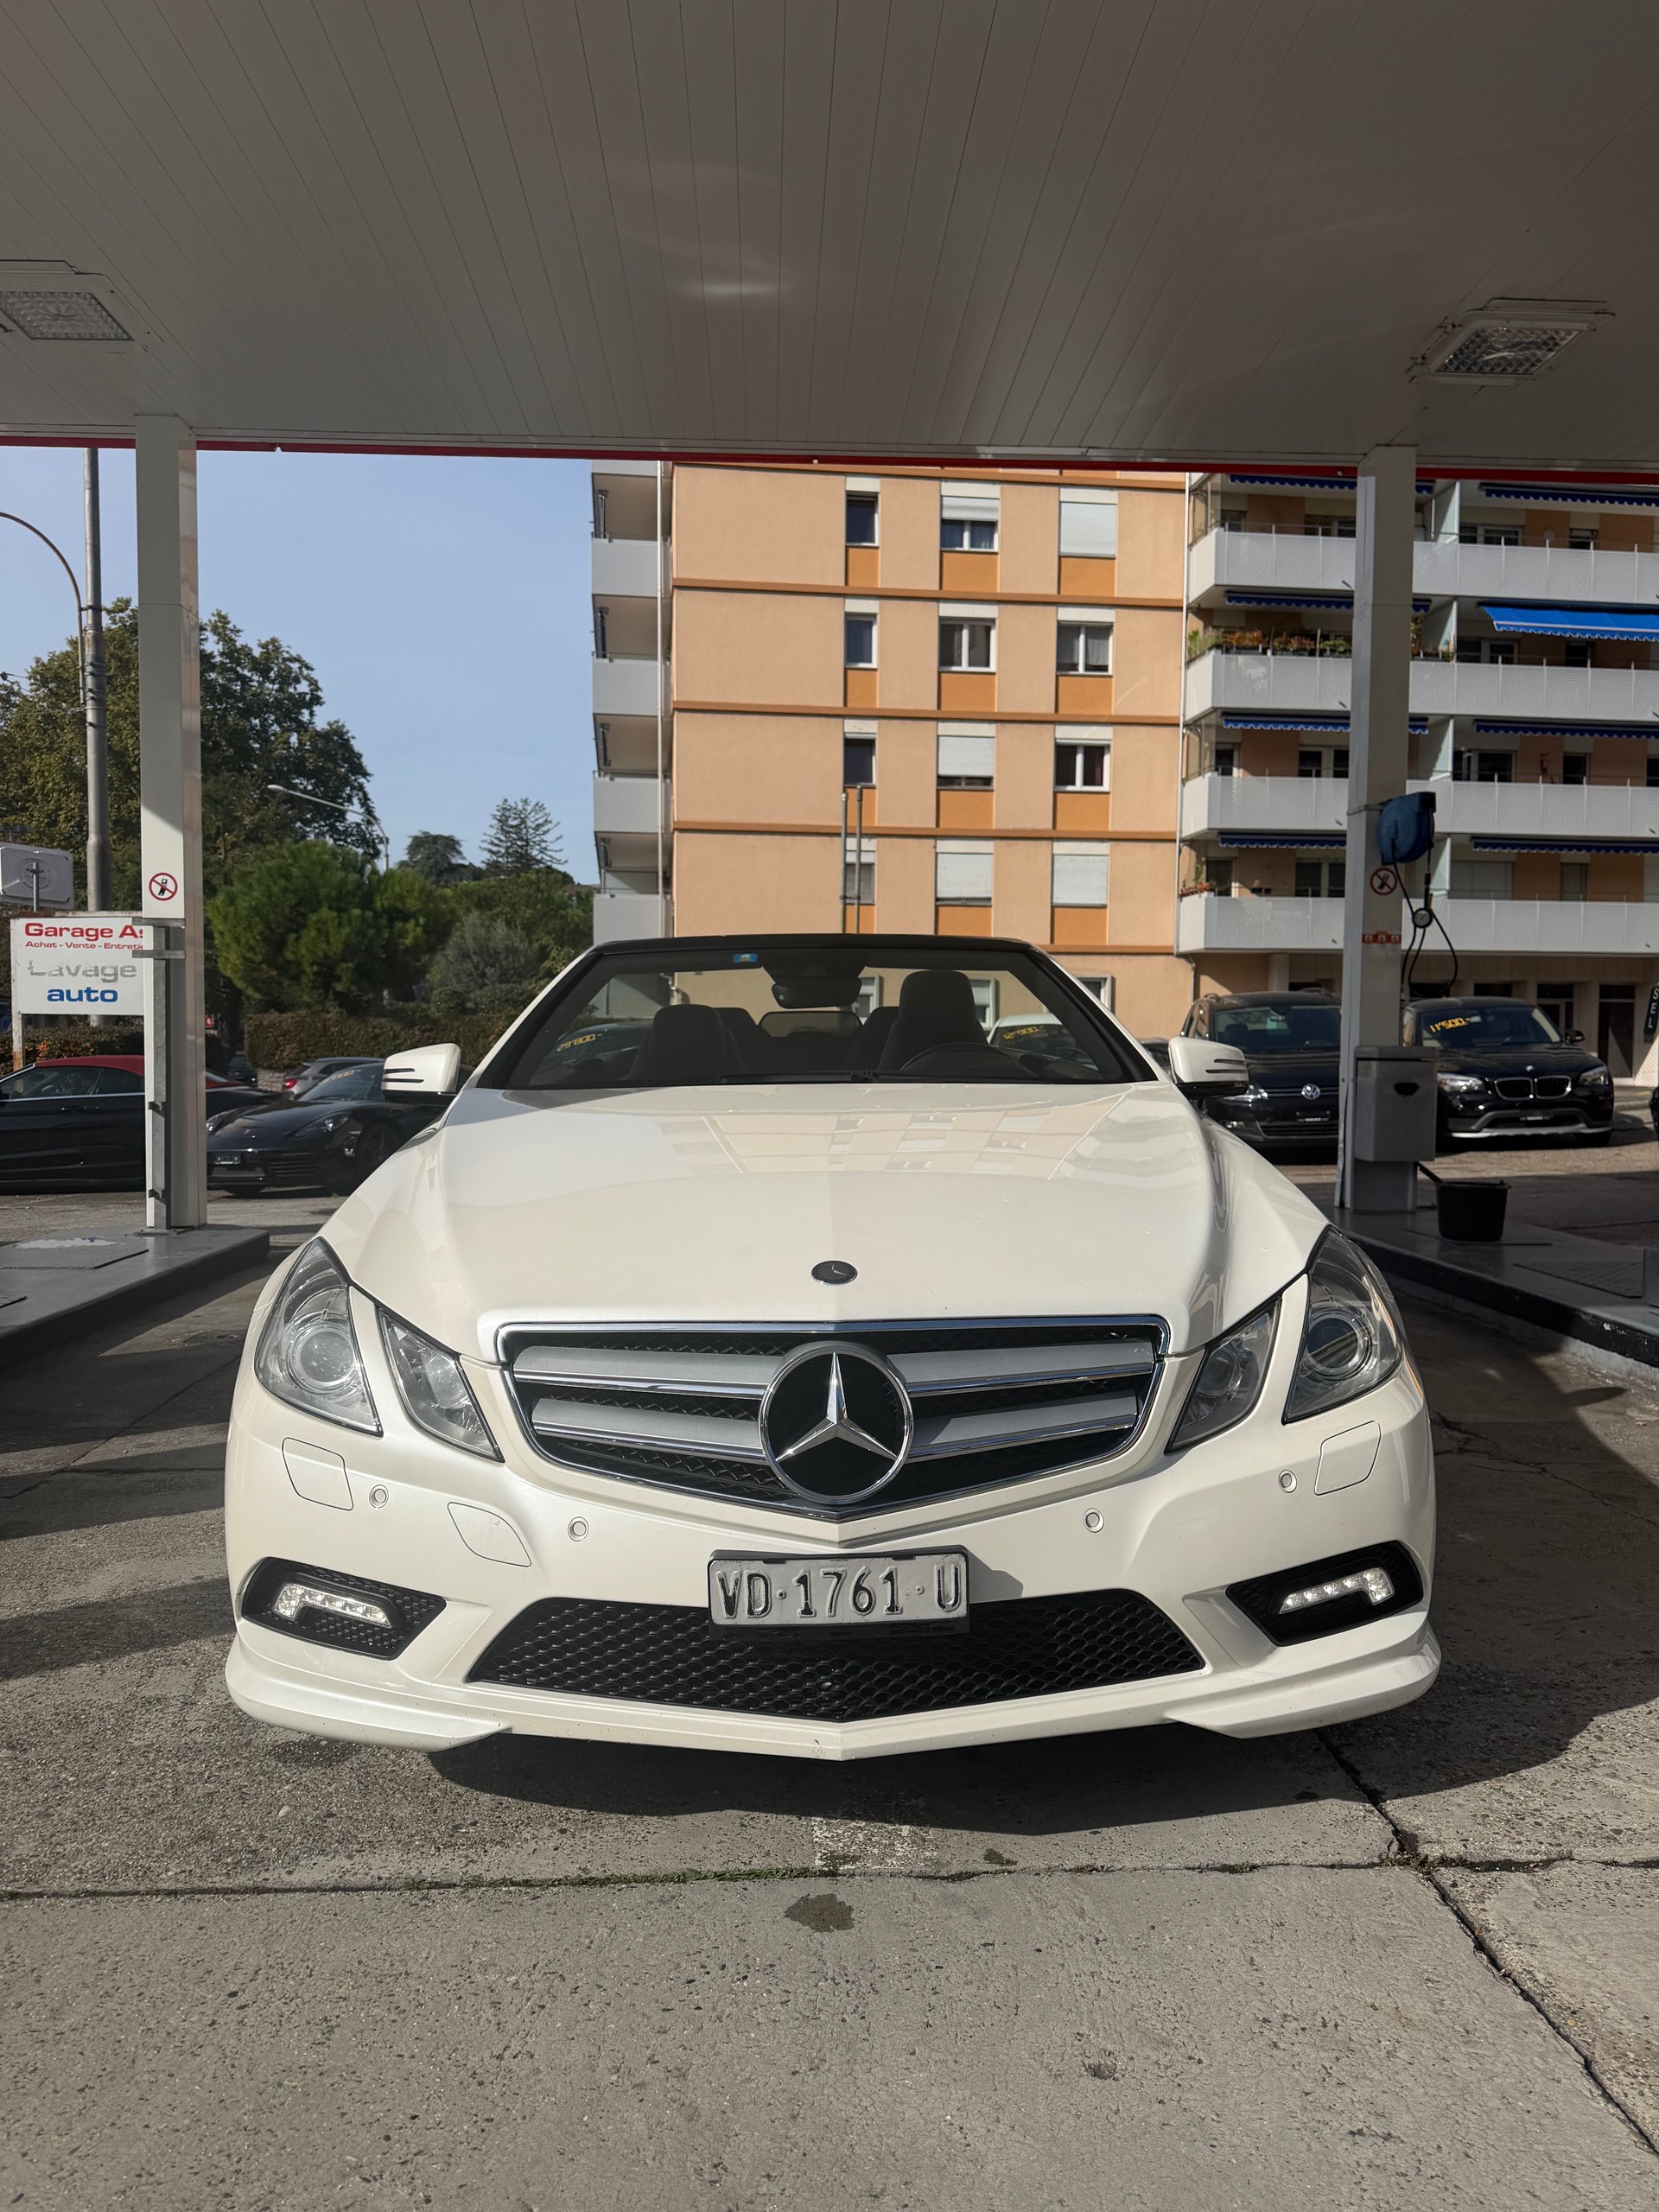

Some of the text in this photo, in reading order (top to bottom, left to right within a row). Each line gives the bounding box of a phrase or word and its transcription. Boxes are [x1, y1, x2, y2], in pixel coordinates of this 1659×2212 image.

[24, 922, 113, 942] Garage
[28, 959, 137, 983] Lavage
[47, 987, 118, 1002] auto
